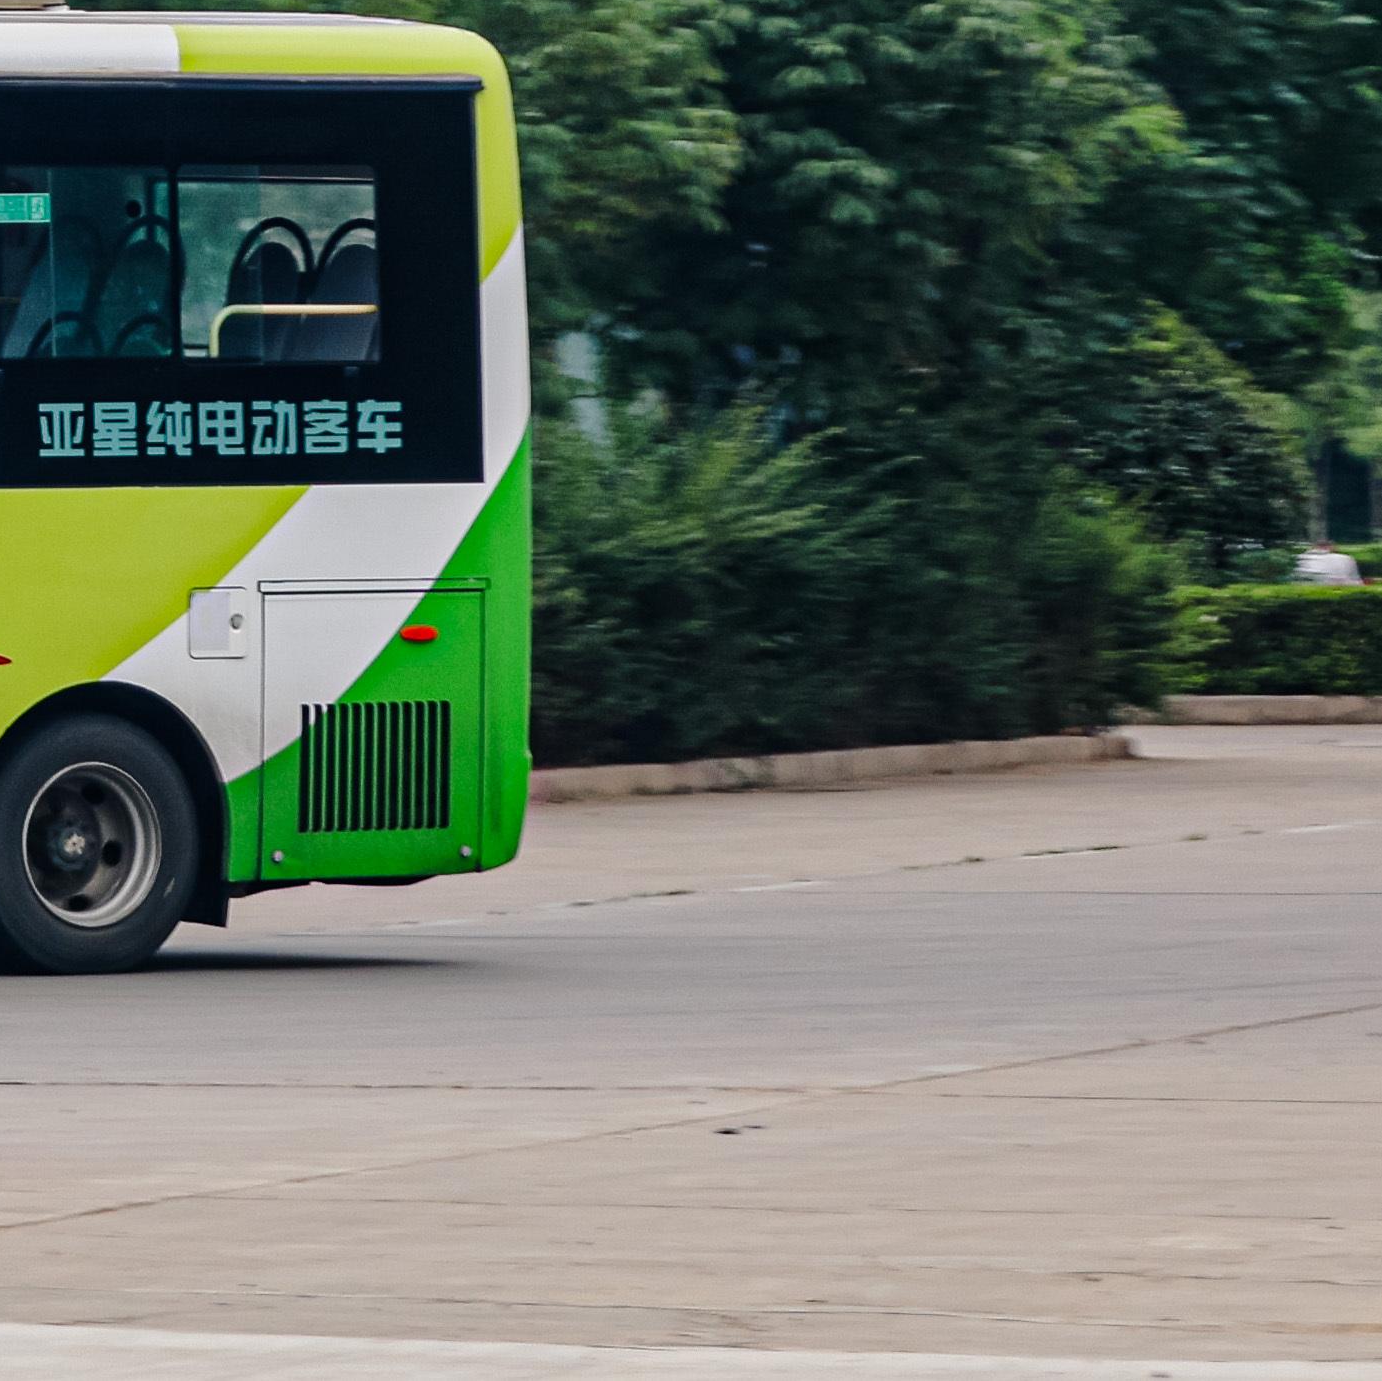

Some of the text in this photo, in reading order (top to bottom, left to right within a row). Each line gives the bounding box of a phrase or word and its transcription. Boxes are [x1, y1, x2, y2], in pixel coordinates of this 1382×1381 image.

[38, 399, 403, 457] 亚星纯电动客车
